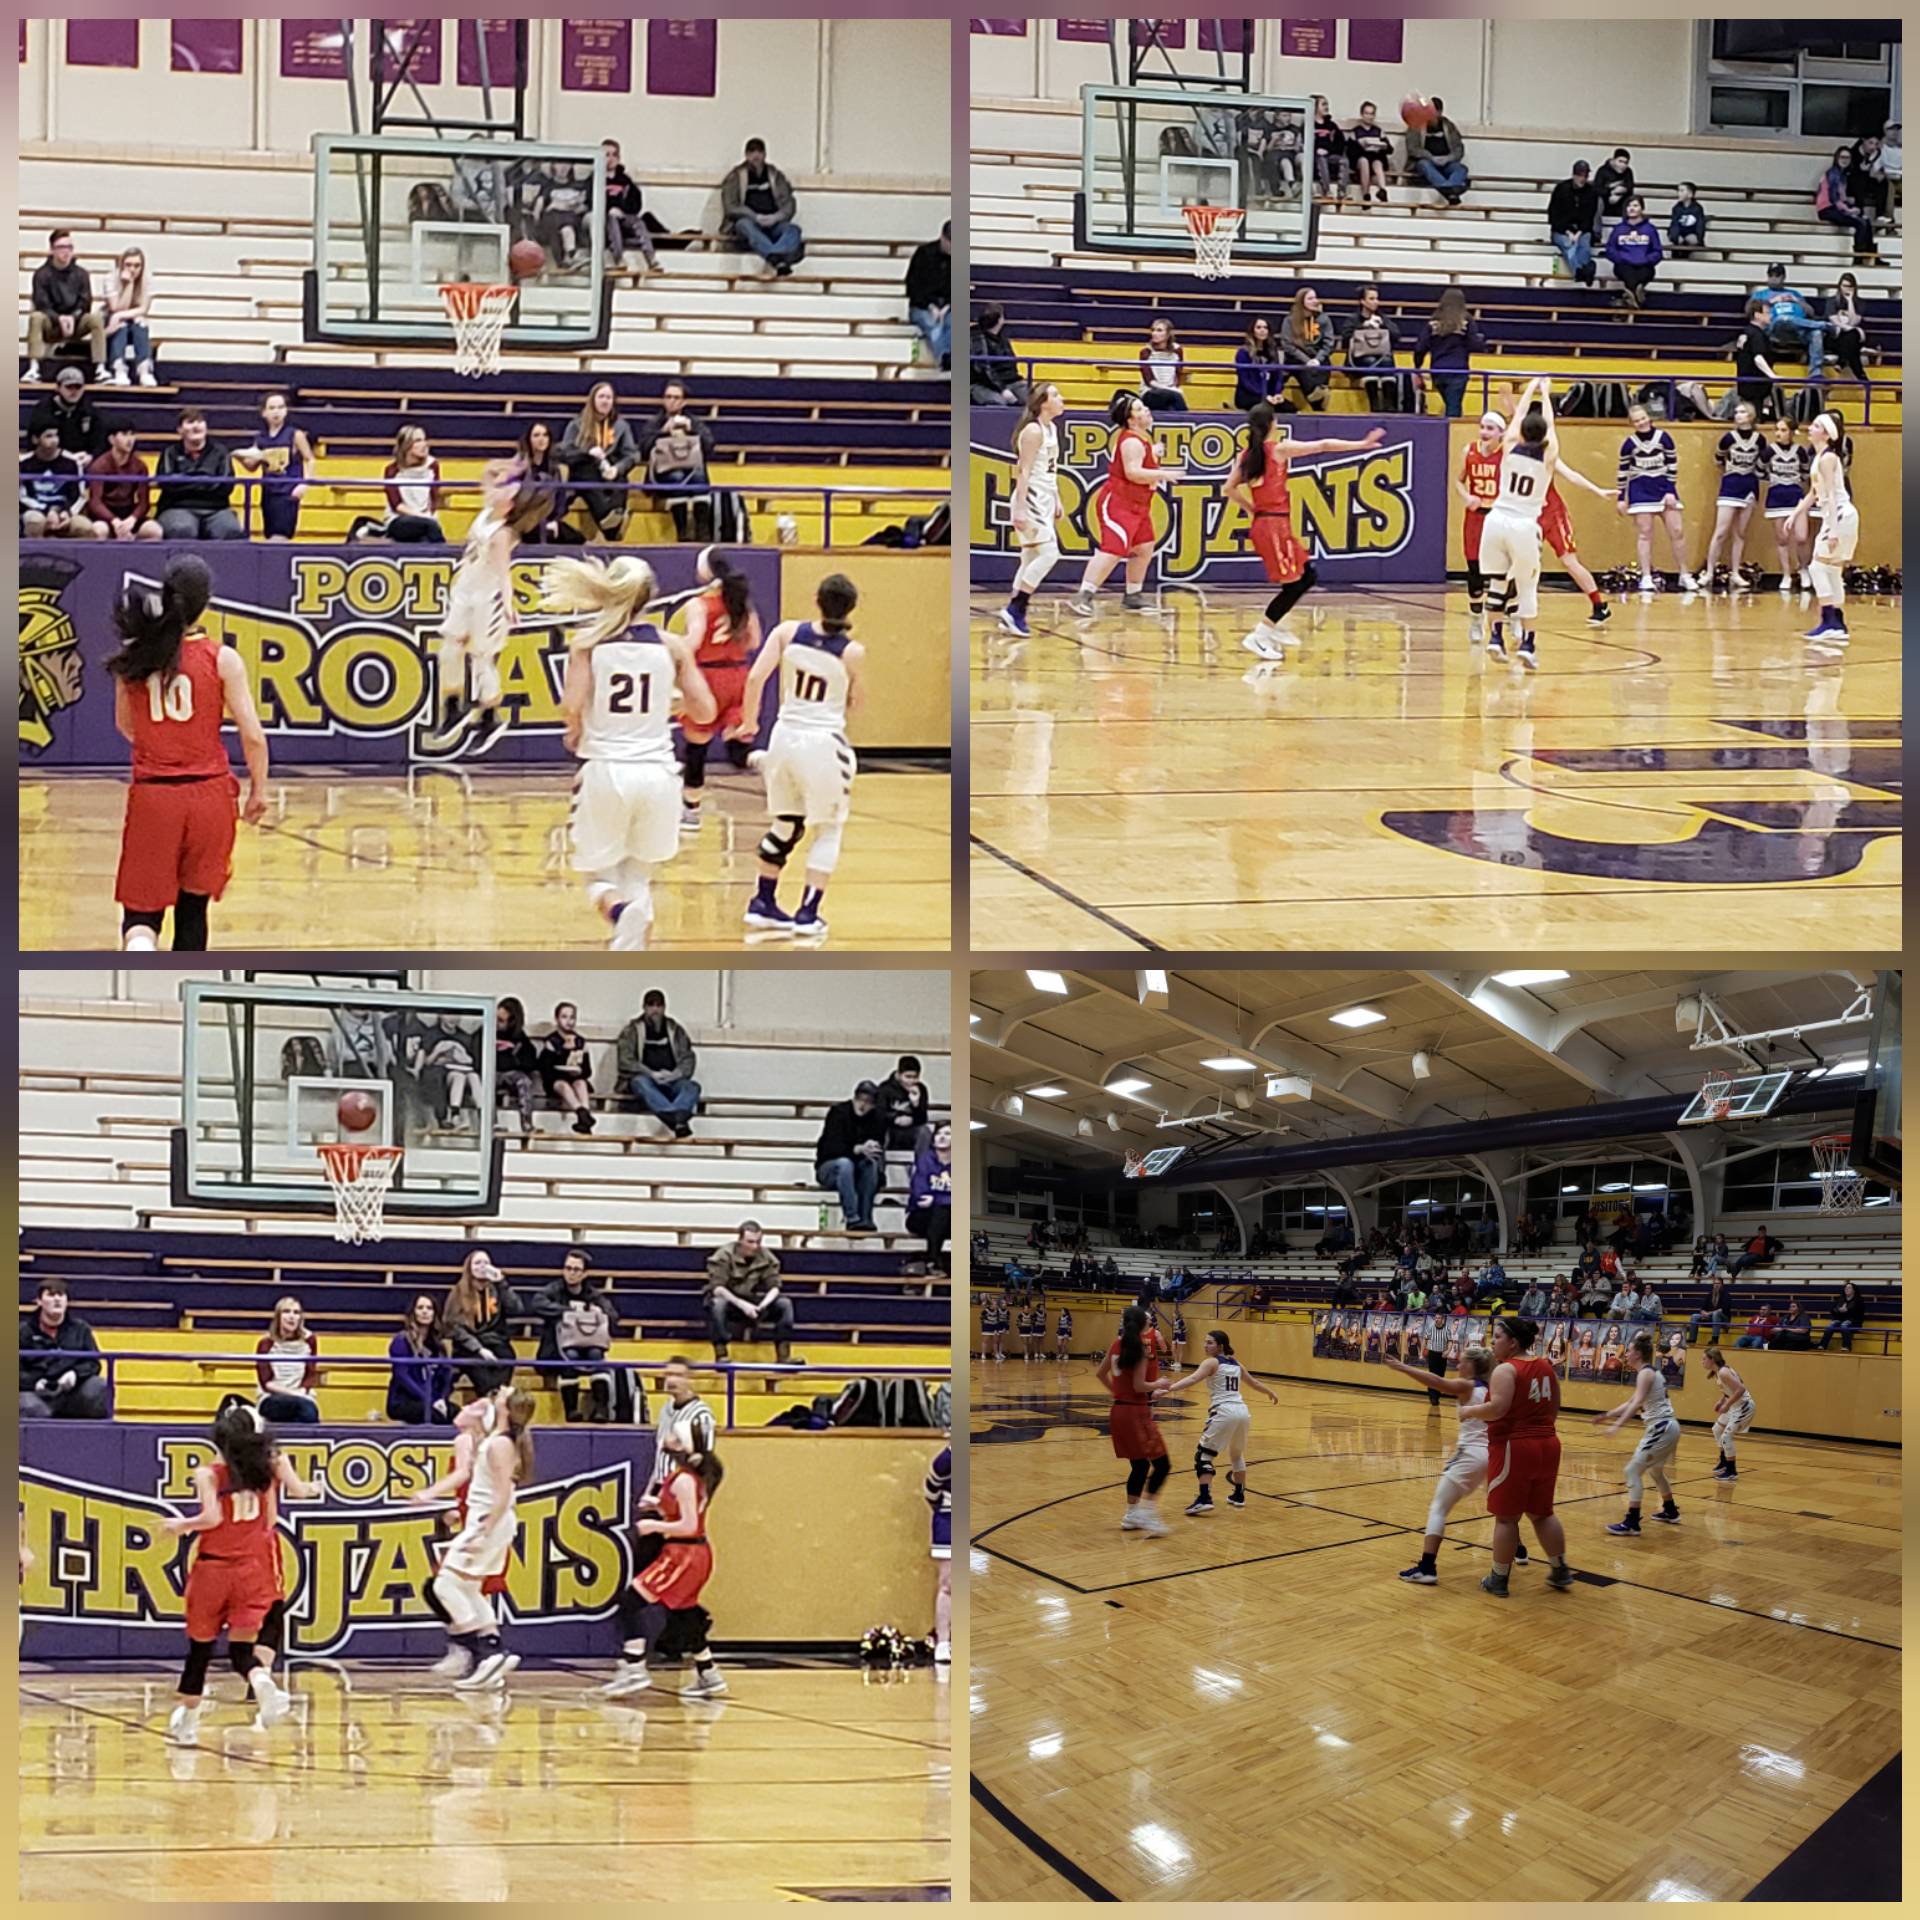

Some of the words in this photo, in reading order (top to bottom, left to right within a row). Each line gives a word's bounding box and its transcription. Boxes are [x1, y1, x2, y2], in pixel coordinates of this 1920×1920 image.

[1068, 425, 1287, 467] PTO
[1473, 479, 1497, 496] 20
[1508, 471, 1535, 497] 10
[295, 561, 577, 615] POTS
[711, 614, 733, 645] 2
[145, 671, 193, 722] 10
[608, 672, 652, 714] 21
[795, 668, 828, 703] 10
[1225, 1375, 1239, 1392] 10
[1529, 1375, 1552, 1403] 44
[163, 1445, 458, 1499] PTOSI
[19, 1479, 622, 1645] TRJANS
